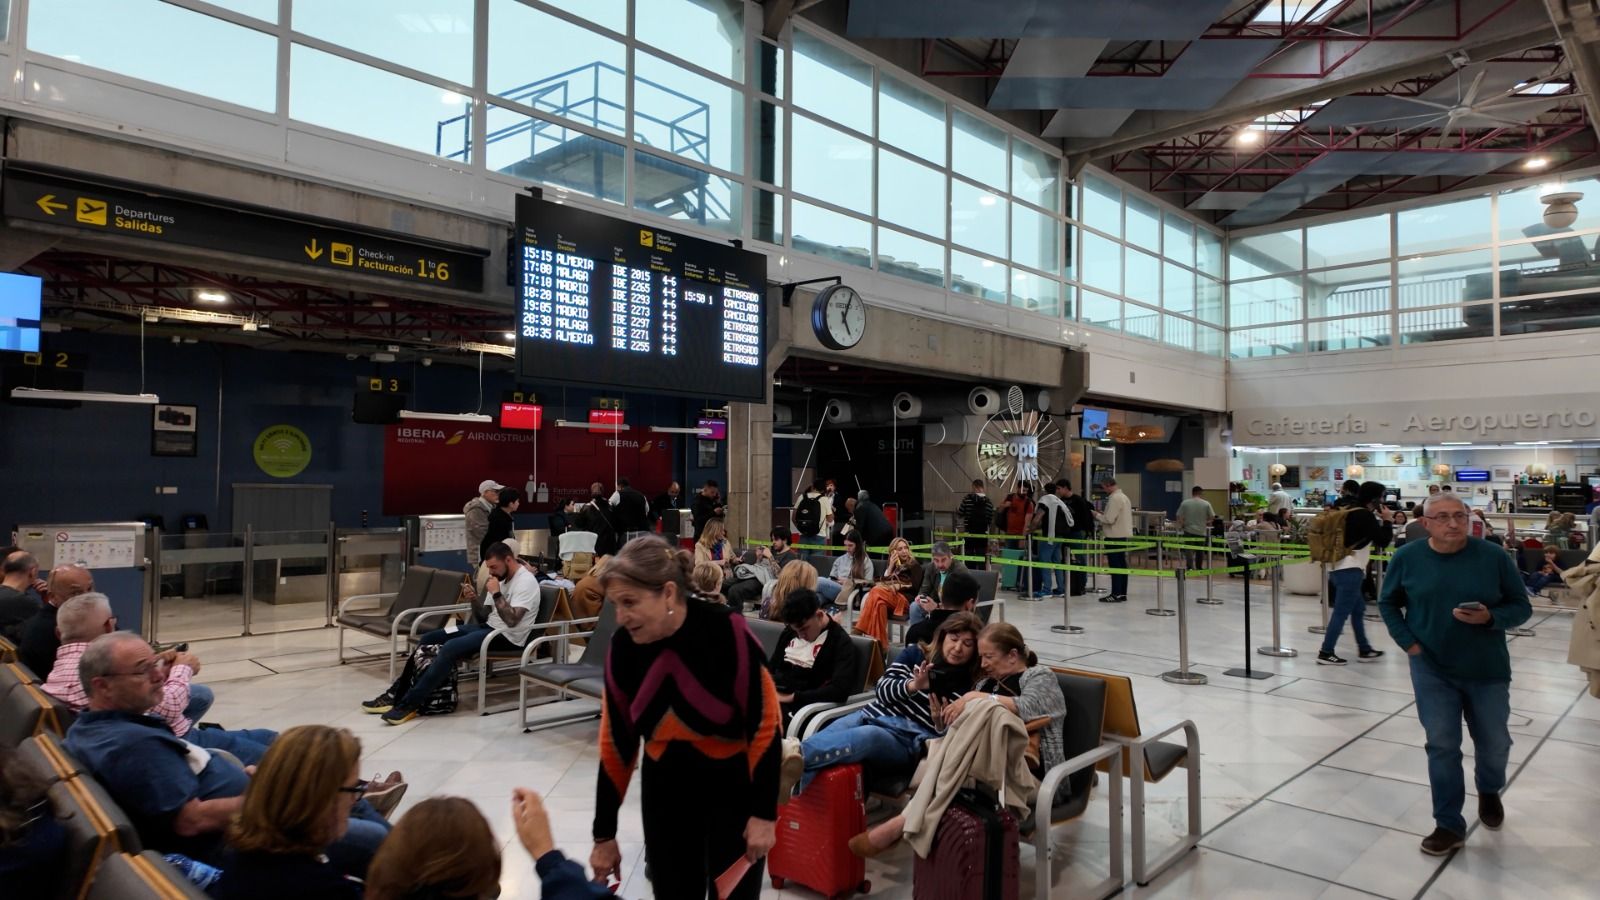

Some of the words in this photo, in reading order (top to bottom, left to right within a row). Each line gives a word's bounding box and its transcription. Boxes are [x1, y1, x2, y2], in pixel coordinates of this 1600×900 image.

[114, 204, 175, 224] Departures
[115, 216, 163, 234] Salidas
[358, 248, 394, 262] Check-in
[358, 258, 414, 276] Facturación
[418, 259, 428, 278] 1
[428, 260, 436, 269] to
[436, 262, 449, 280] 6
[524, 247, 552, 262] 15:15
[556, 253, 594, 270] ALMERIA
[613, 265, 627, 277] IBE
[631, 268, 650, 282] 2015
[662, 275, 677, 287] 4-6
[709, 296, 713, 305] 1
[724, 288, 759, 302] RETRASADO
[524, 260, 552, 274] 17:00
[556, 266, 588, 282] MALAGA
[613, 277, 627, 289] IBE
[631, 281, 650, 293] 2265
[662, 287, 677, 299] 4-6
[724, 299, 759, 313] CANCELADO
[524, 273, 552, 287] 17:10
[556, 279, 588, 294] MADRID
[613, 289, 627, 301] IBE
[631, 293, 650, 305] 2293
[662, 299, 677, 310] 4-6
[724, 310, 758, 323] CANCELADO
[524, 286, 552, 300] 18:20
[556, 291, 588, 306] MALAGA
[613, 301, 627, 313] IBE
[631, 304, 650, 317] 2273
[662, 310, 677, 321] 4-6
[724, 320, 758, 334] RETRASADO
[524, 299, 551, 313] 19:05
[556, 305, 588, 319] MADRID
[612, 313, 627, 325] IBE
[631, 316, 650, 329] 2297
[662, 322, 677, 333] 4-6
[724, 332, 758, 344] RETRASADO
[523, 312, 551, 326] 20:30
[556, 317, 588, 331] MALAGA
[612, 326, 626, 338] IBE
[631, 329, 649, 340] 2271
[662, 333, 677, 344] 4-6
[724, 342, 758, 354] RETRASADO
[523, 326, 551, 339] 20:35
[556, 330, 593, 344] ALMERIA
[612, 338, 626, 349] IBE
[631, 341, 650, 352] 2255
[662, 345, 677, 356] 4-6
[724, 353, 758, 366] RETRASADO
[56, 353, 69, 368] 2
[390, 379, 398, 392] 3
[528, 393, 536, 403] 4
[1247, 413, 1367, 436] Cafetería
[1403, 407, 1596, 437] Aeropuerto
[397, 428, 445, 440] IBERIA
[605, 440, 639, 448] IBERIA
